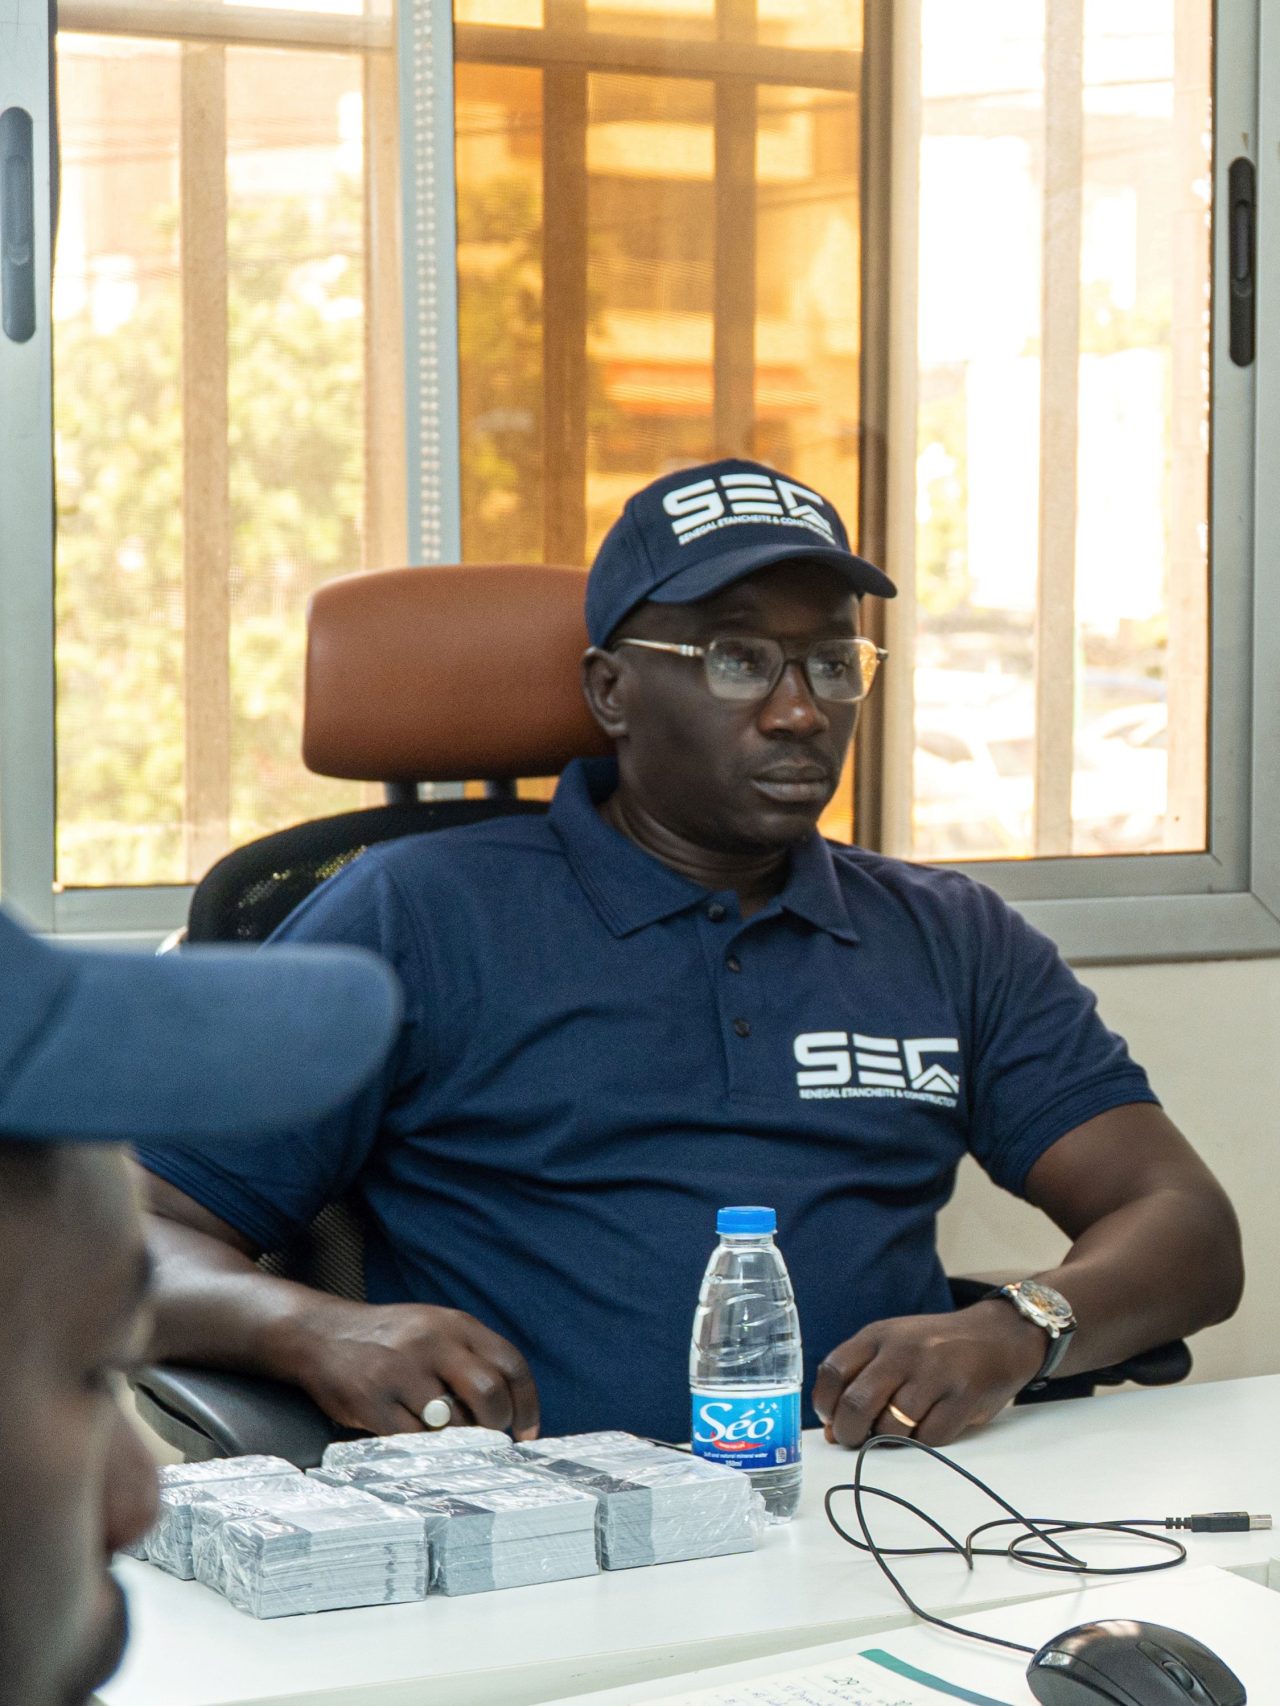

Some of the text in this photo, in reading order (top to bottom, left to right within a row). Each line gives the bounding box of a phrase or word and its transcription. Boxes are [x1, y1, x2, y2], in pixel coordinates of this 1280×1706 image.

[799, 1088, 841, 1100] SENEGAL
[842, 1087, 896, 1098] ETANCHEITE
[694, 1402, 775, 1443] Séo
